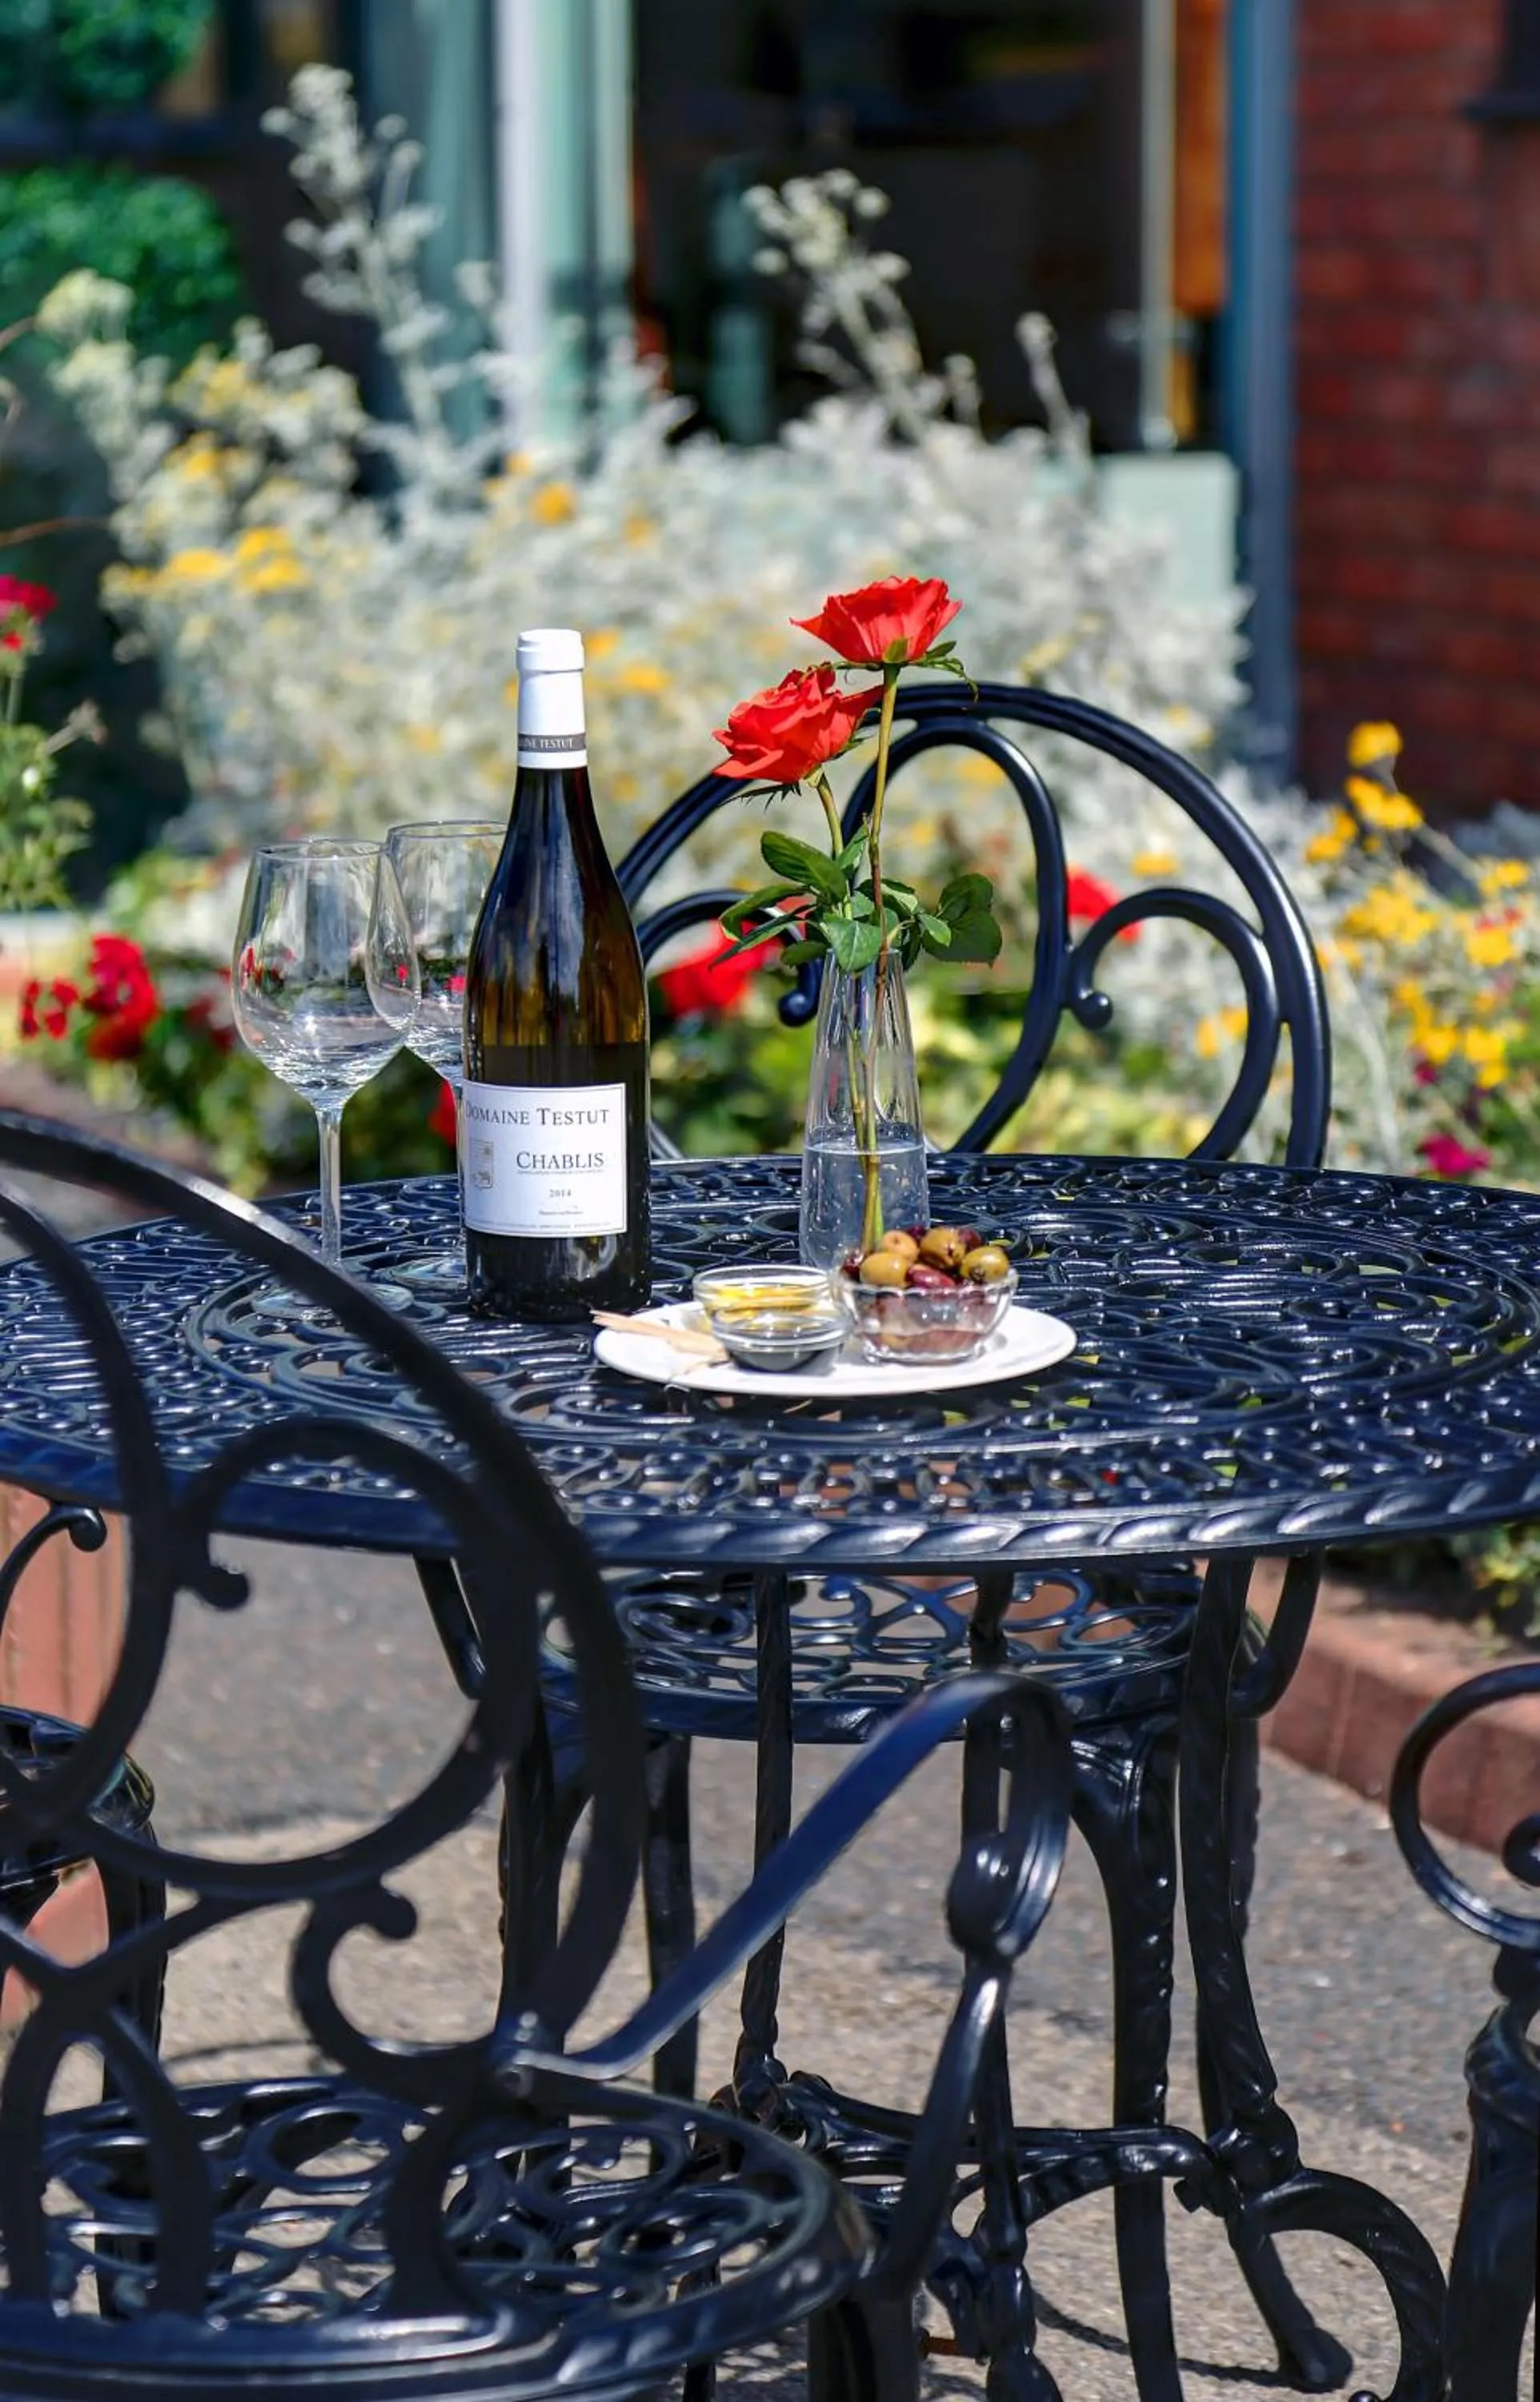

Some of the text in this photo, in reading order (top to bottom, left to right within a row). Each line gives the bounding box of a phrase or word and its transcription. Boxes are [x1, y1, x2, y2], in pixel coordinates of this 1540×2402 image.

[536, 1107, 609, 1126] TESTUT
[516, 1151, 604, 1169] CHABLIS
[549, 1189, 571, 1198] 2014
